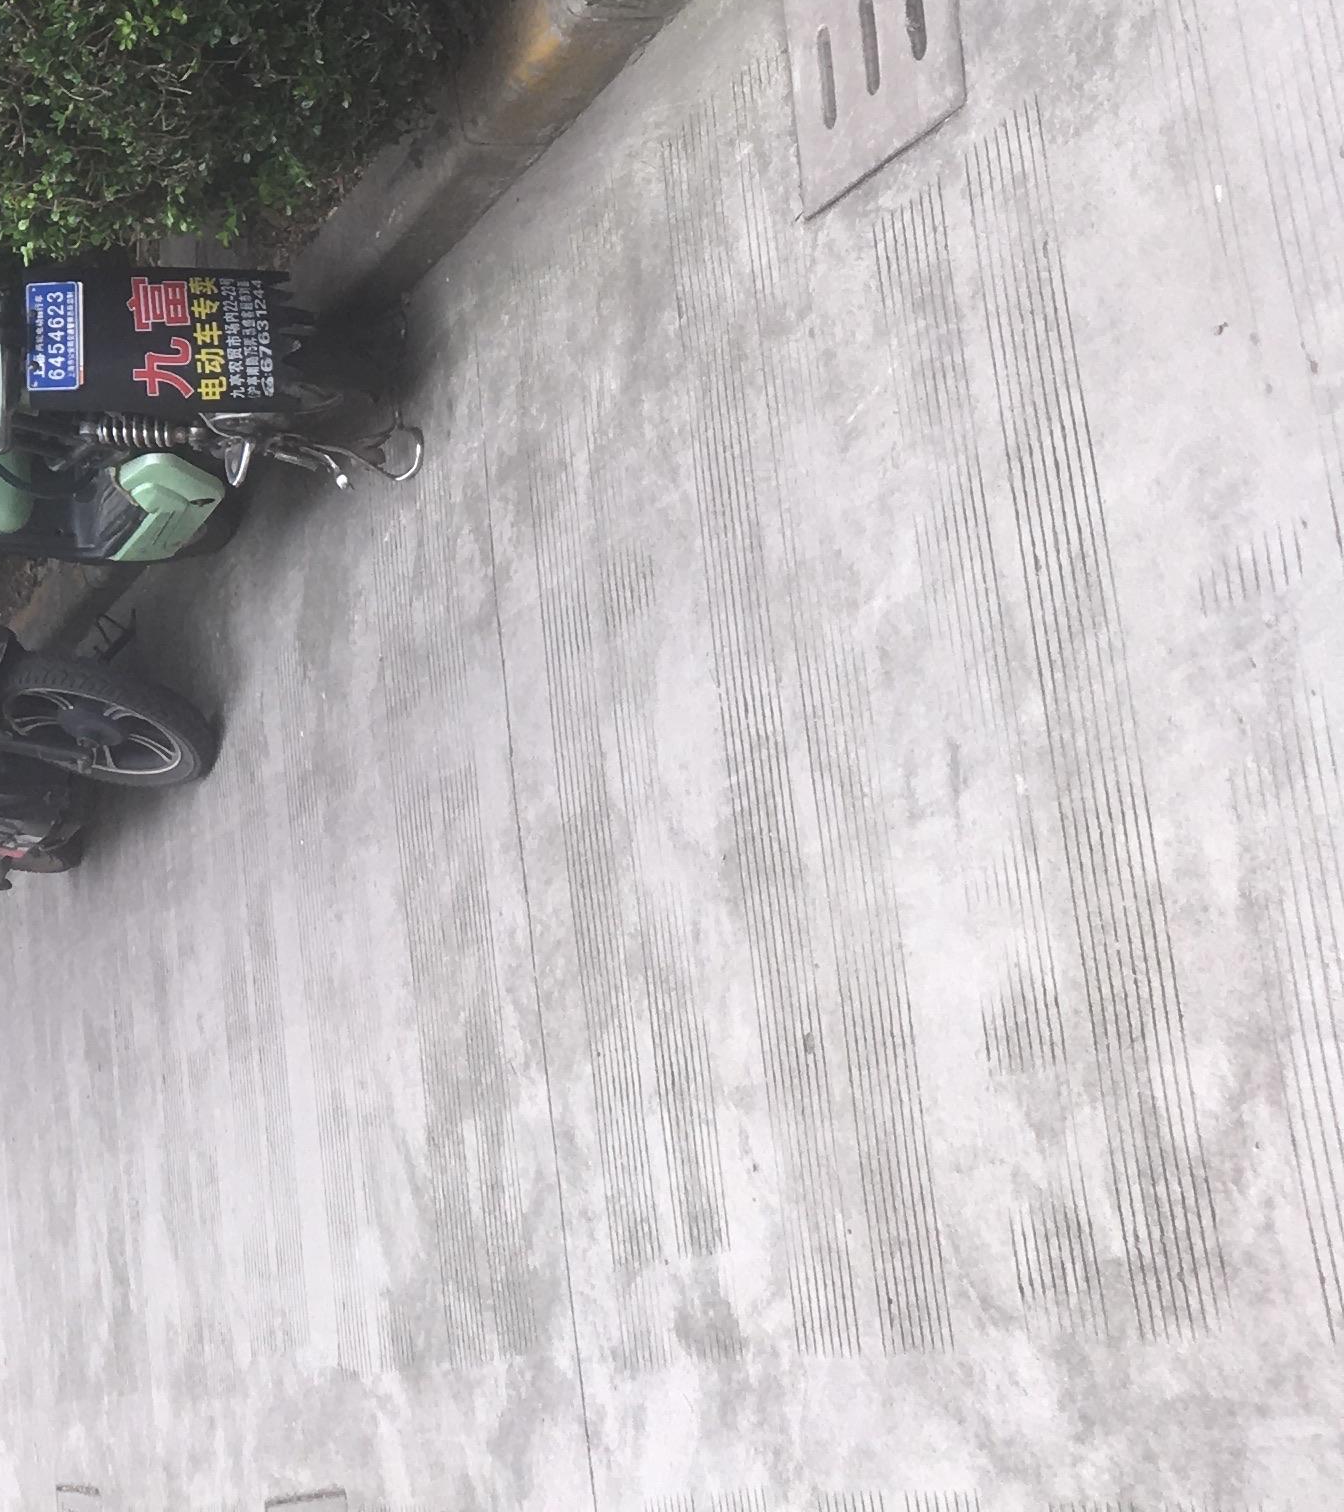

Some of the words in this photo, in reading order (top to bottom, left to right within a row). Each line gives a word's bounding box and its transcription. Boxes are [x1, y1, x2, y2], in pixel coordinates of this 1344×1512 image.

[46, 291, 65, 380] 6454623
[188, 276, 227, 400] 电动车专卖
